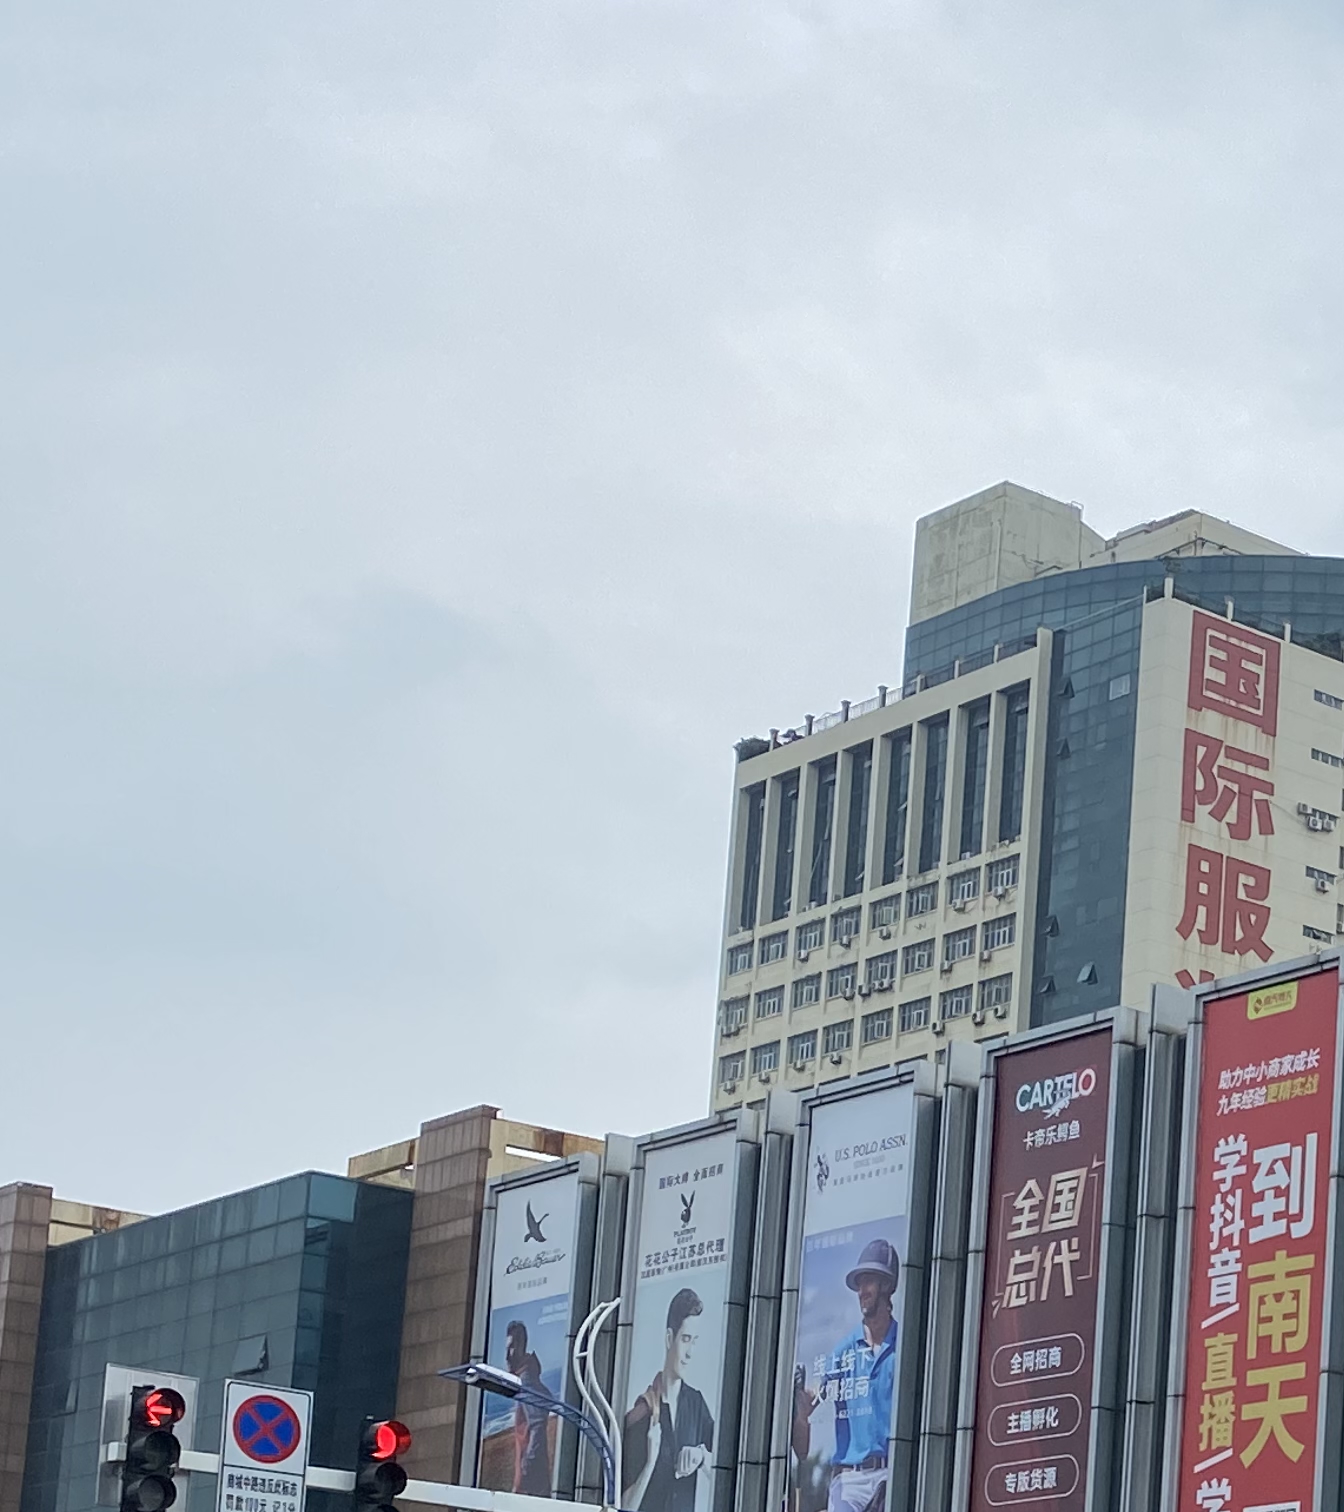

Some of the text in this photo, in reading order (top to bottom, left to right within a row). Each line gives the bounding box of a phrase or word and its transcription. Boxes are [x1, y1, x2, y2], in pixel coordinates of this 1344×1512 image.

[1176, 610, 1281, 990] 国际服
[1218, 1048, 1320, 1089] 助力中小商家成长
[1016, 1068, 1096, 1112] CARTELO
[853, 1141, 878, 1157] POLO
[1007, 1166, 1088, 1241] 全国
[1000, 1237, 1081, 1311] 总代
[1239, 1133, 1318, 1468] 到南天
[813, 1347, 875, 1376] 线上线下
[1010, 1346, 1062, 1375] 全网招商
[1007, 1406, 1059, 1434] 主播孵化
